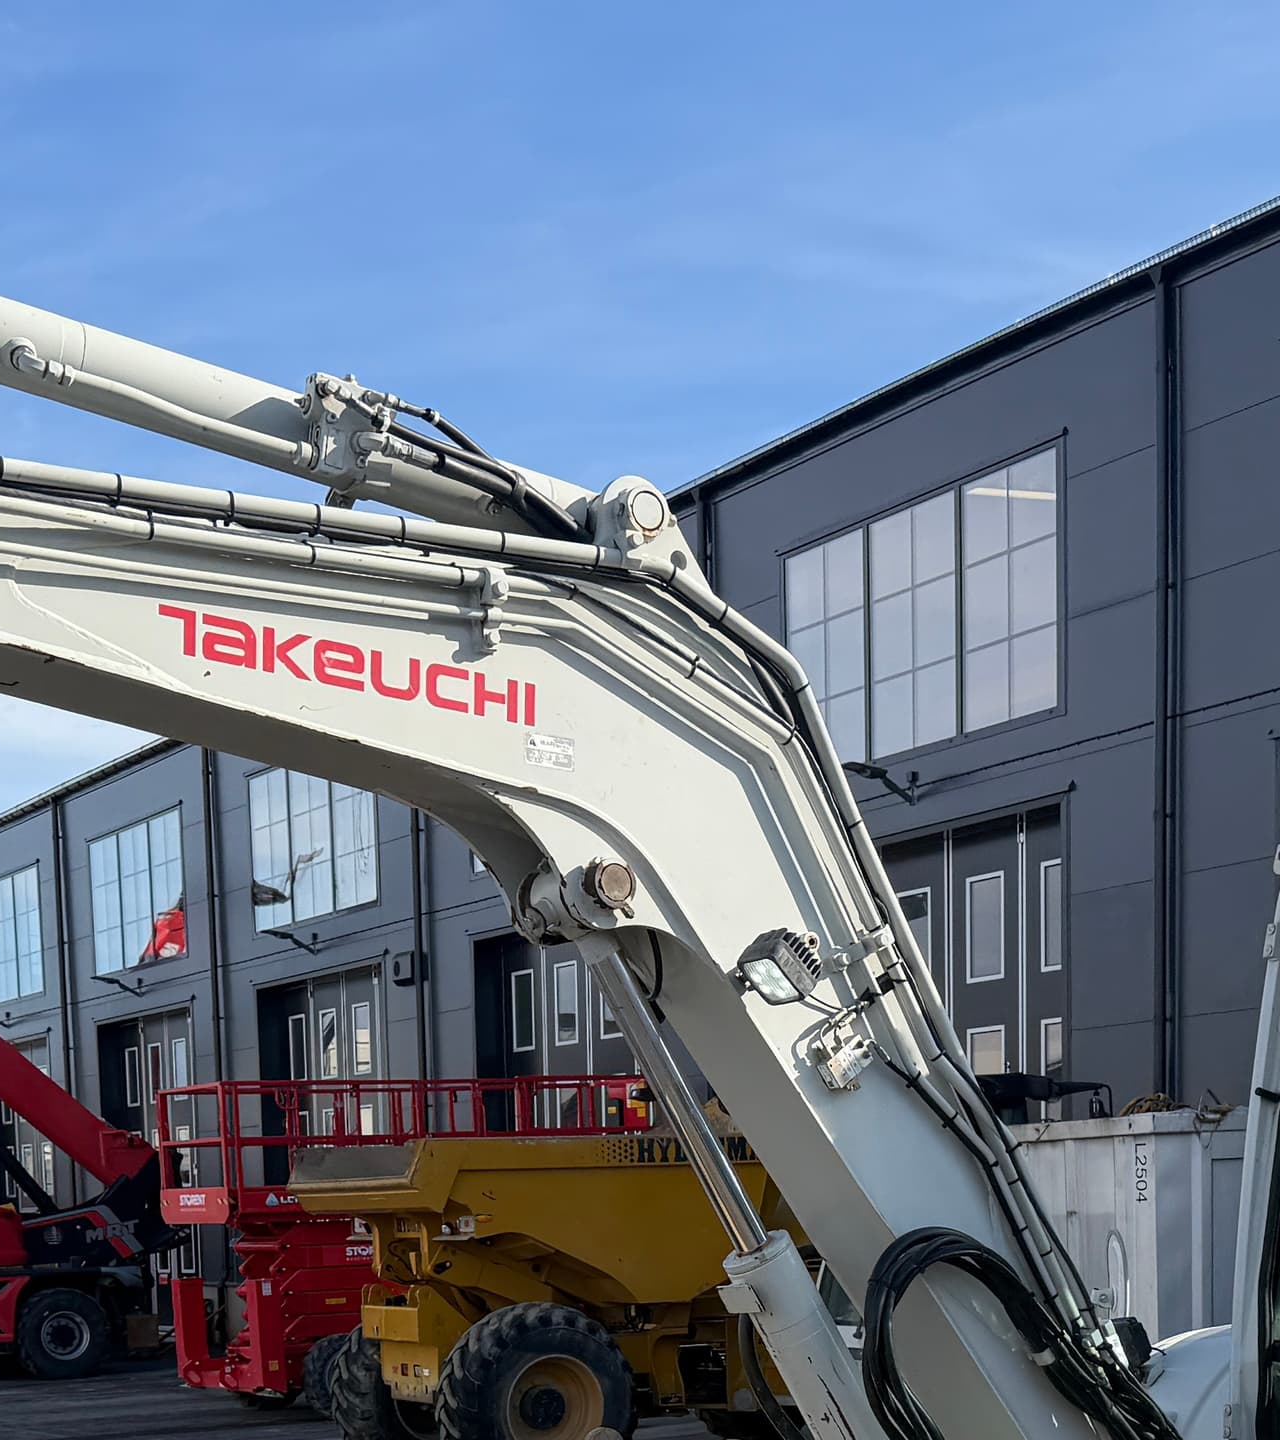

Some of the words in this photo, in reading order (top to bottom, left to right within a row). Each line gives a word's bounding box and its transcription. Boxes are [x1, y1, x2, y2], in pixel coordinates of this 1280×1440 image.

[158, 604, 536, 727] TAKEUCHI
[1134, 1143, 1148, 1204] L2504
[86, 1218, 140, 1244] MRT
